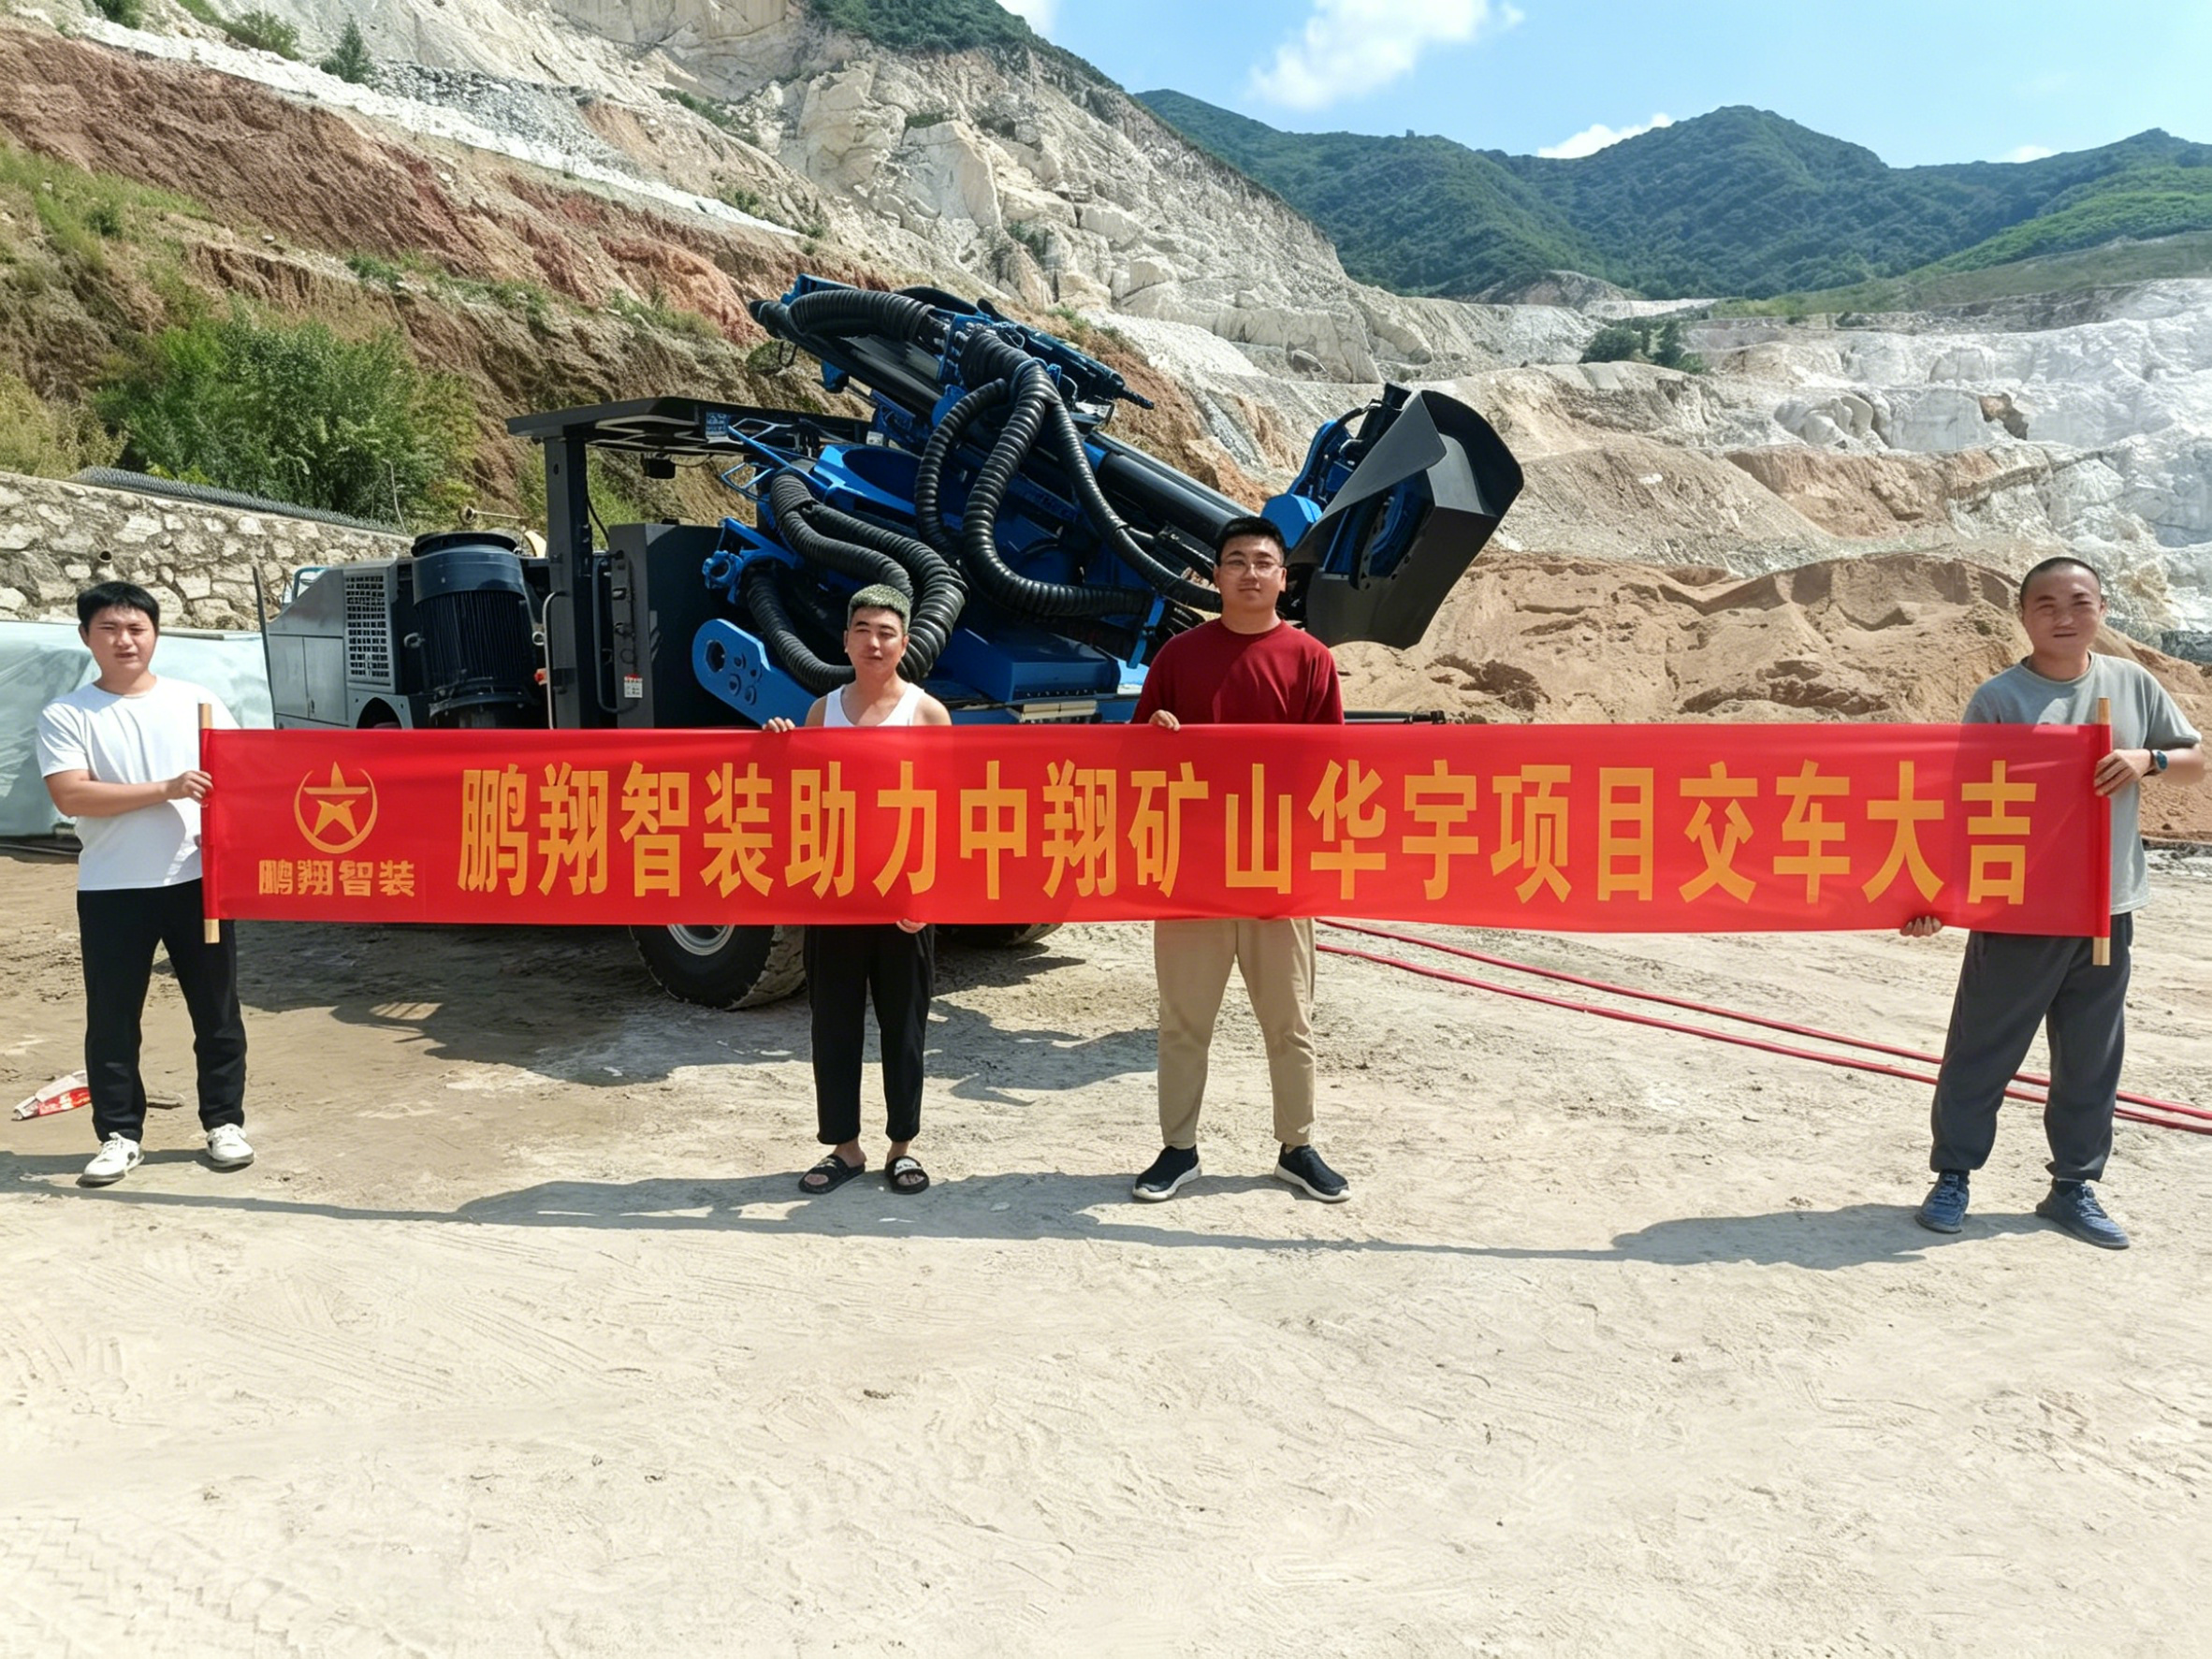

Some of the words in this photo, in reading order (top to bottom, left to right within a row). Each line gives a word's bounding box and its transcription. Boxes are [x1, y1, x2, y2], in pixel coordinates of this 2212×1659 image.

[258, 859, 415, 897] 鹏翔智装
[458, 759, 2038, 905] 鹏翔智装助力中翔矿山华宇项目交车大吉
